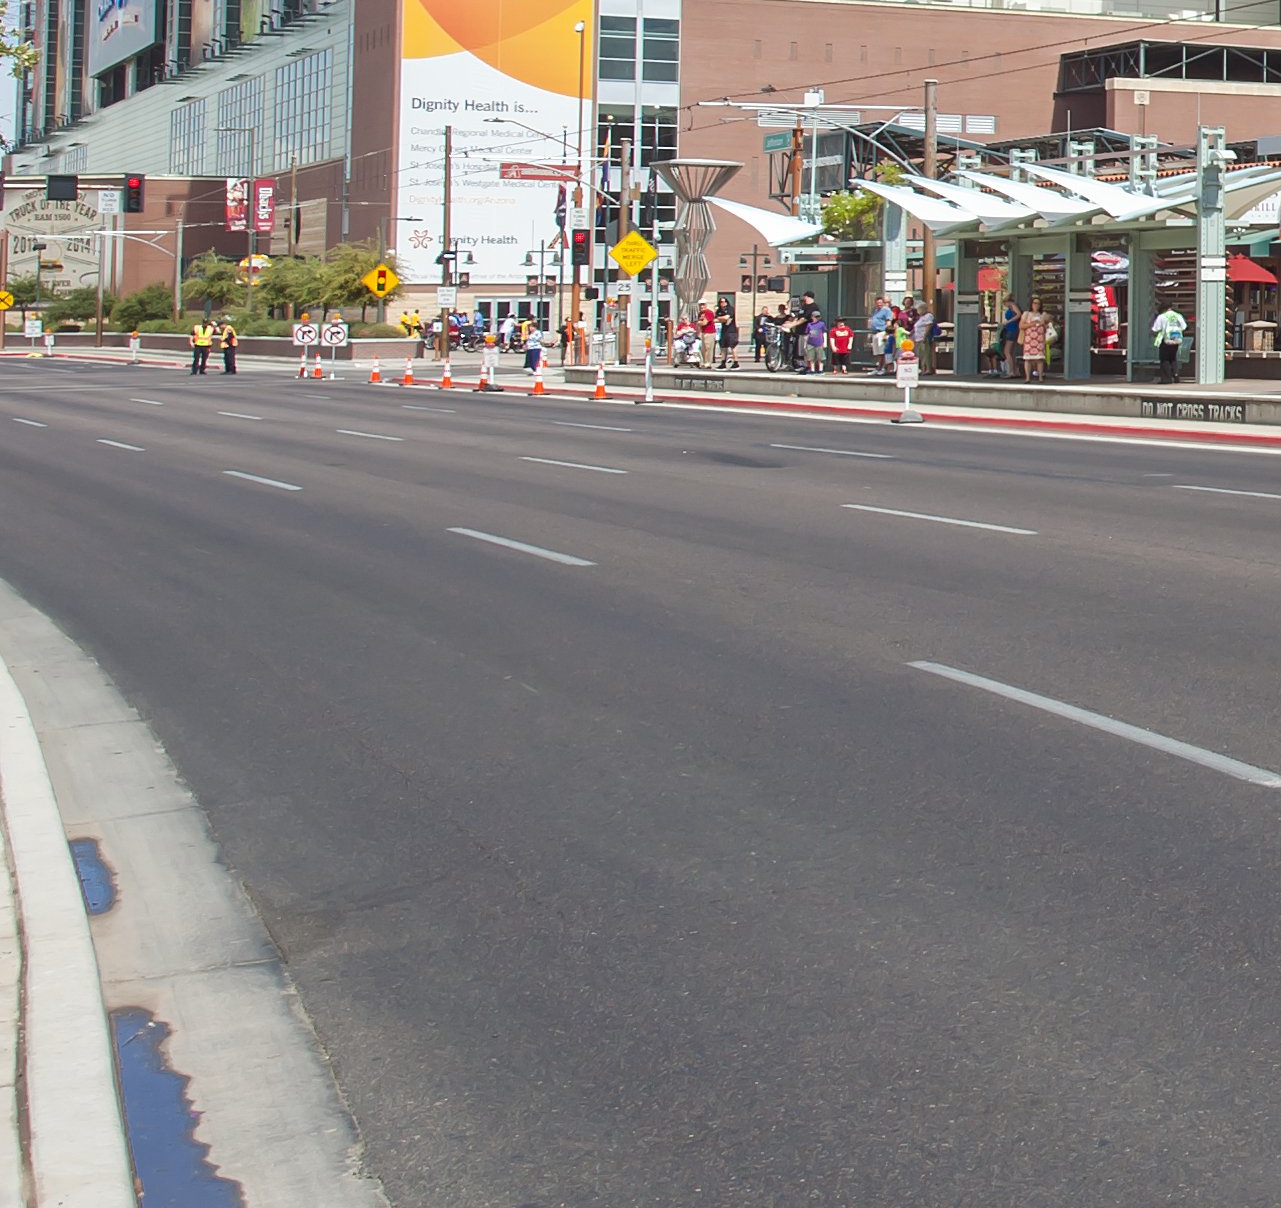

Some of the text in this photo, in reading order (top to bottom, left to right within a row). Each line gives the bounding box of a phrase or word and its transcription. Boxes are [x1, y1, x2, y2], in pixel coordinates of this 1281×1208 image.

[411, 97, 538, 113] Dignity Health is...
[410, 144, 436, 154] Mercy
[505, 147, 533, 155] Center
[9, 200, 97, 222] TRUCK OF THE YEAR
[438, 235, 518, 247] Dgnity Health
[618, 283, 631, 291] 25
[1142, 401, 1243, 421] DO NOT CROSS TRACKS
